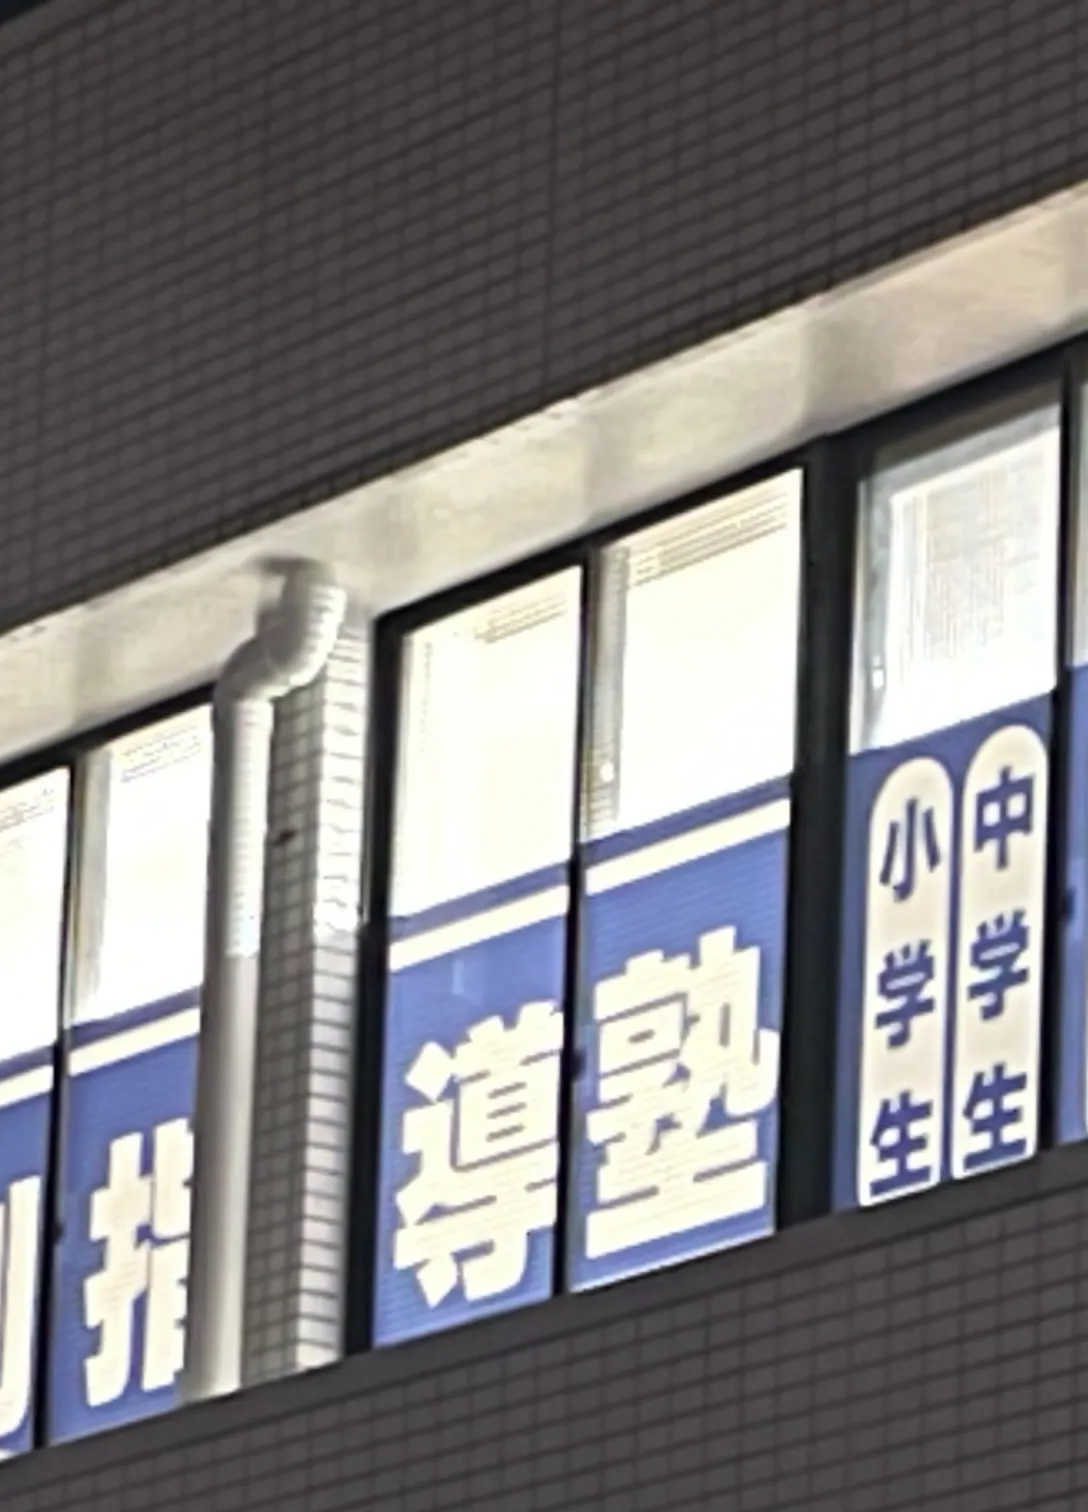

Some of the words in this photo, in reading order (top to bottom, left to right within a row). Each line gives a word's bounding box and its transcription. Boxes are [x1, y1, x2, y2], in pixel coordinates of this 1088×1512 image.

[868, 797, 941, 1197] 小学生
[962, 766, 1035, 1172] 中学生
